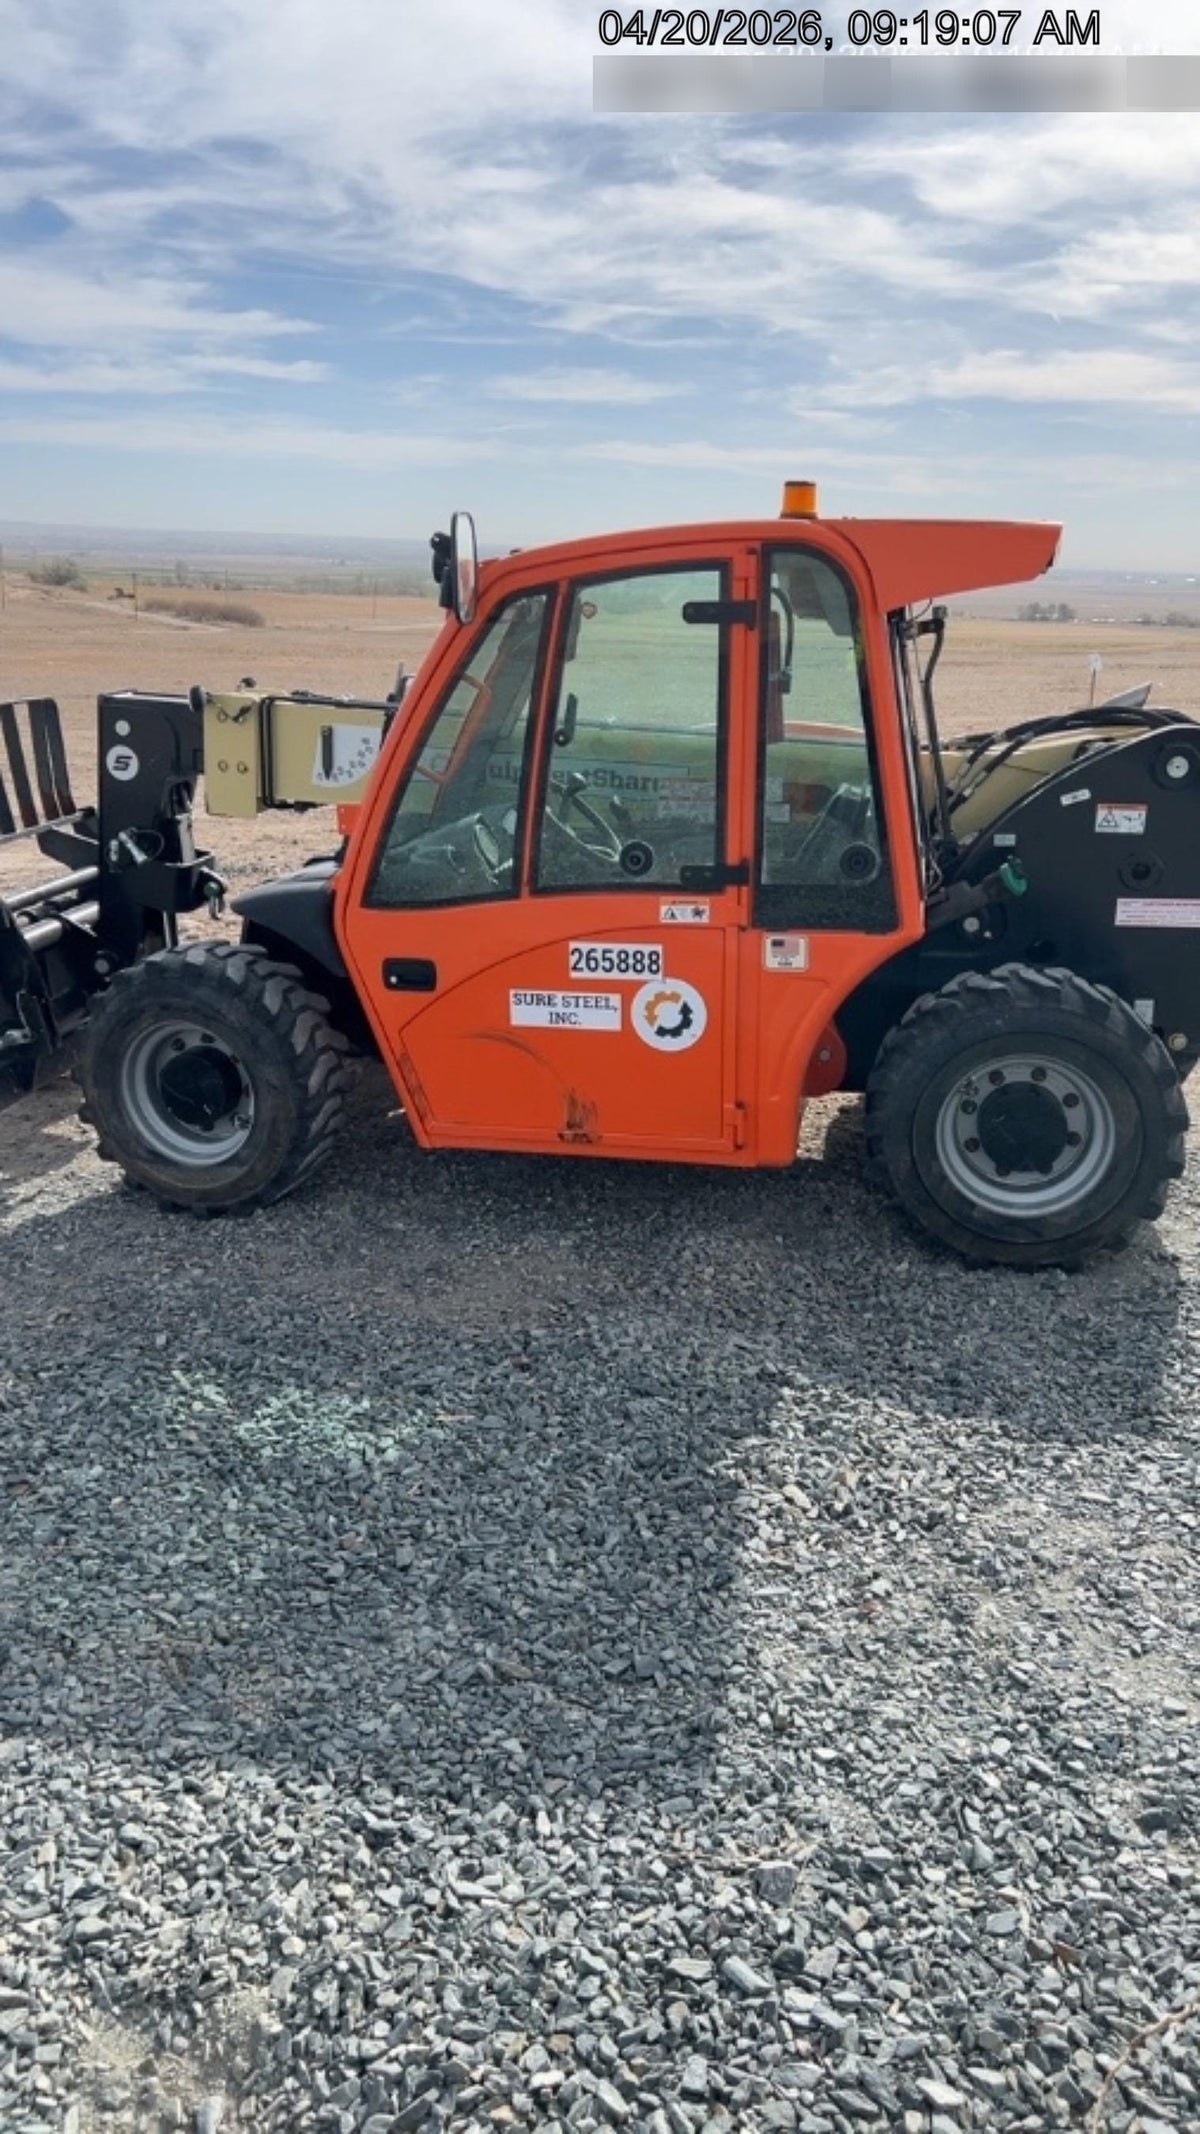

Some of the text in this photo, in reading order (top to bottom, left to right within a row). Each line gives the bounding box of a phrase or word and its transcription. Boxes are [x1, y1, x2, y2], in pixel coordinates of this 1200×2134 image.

[570, 947, 660, 975] 265888
[512, 993, 618, 1013] SURE STEEL,
[548, 1011, 582, 1026] INC.
